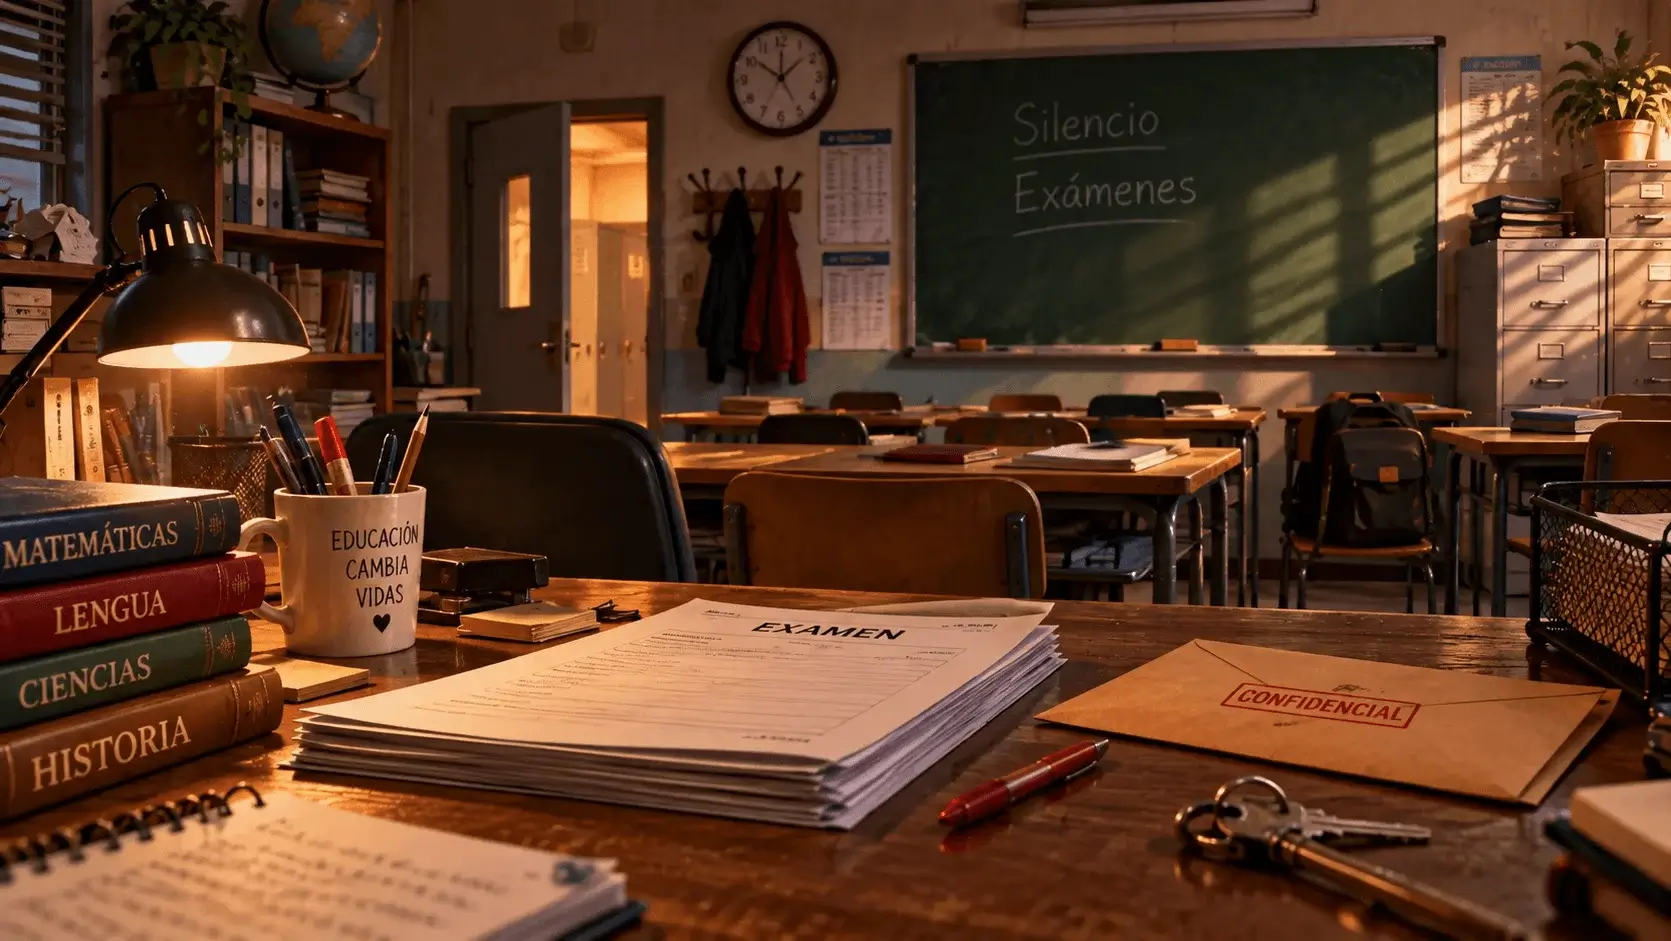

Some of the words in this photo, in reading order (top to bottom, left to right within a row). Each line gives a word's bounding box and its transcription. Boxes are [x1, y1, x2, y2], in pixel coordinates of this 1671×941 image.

[775, 35, 788, 48] 12
[745, 56, 758, 67] 10
[808, 52, 817, 65] 2
[739, 74, 748, 85] 9
[814, 71, 822, 84] 3
[808, 90, 817, 103] 4
[759, 104, 768, 118] 7
[776, 110, 785, 122] 6
[795, 104, 804, 117] 5
[1013, 101, 1160, 146] Silencio
[1014, 171, 1197, 214] Exámenes
[2, 520, 179, 569] MATEMÁTICAS
[331, 520, 419, 552] EDUCACIÓN
[345, 554, 409, 581] CAMBIA
[356, 583, 404, 609] VIDAS
[53, 589, 167, 636] LENGUA
[750, 621, 907, 641] EXAMEN
[18, 653, 152, 709] CIENCIAS
[1237, 689, 1403, 722] CONFIDENCIAL
[31, 715, 192, 793] HISTORIA
